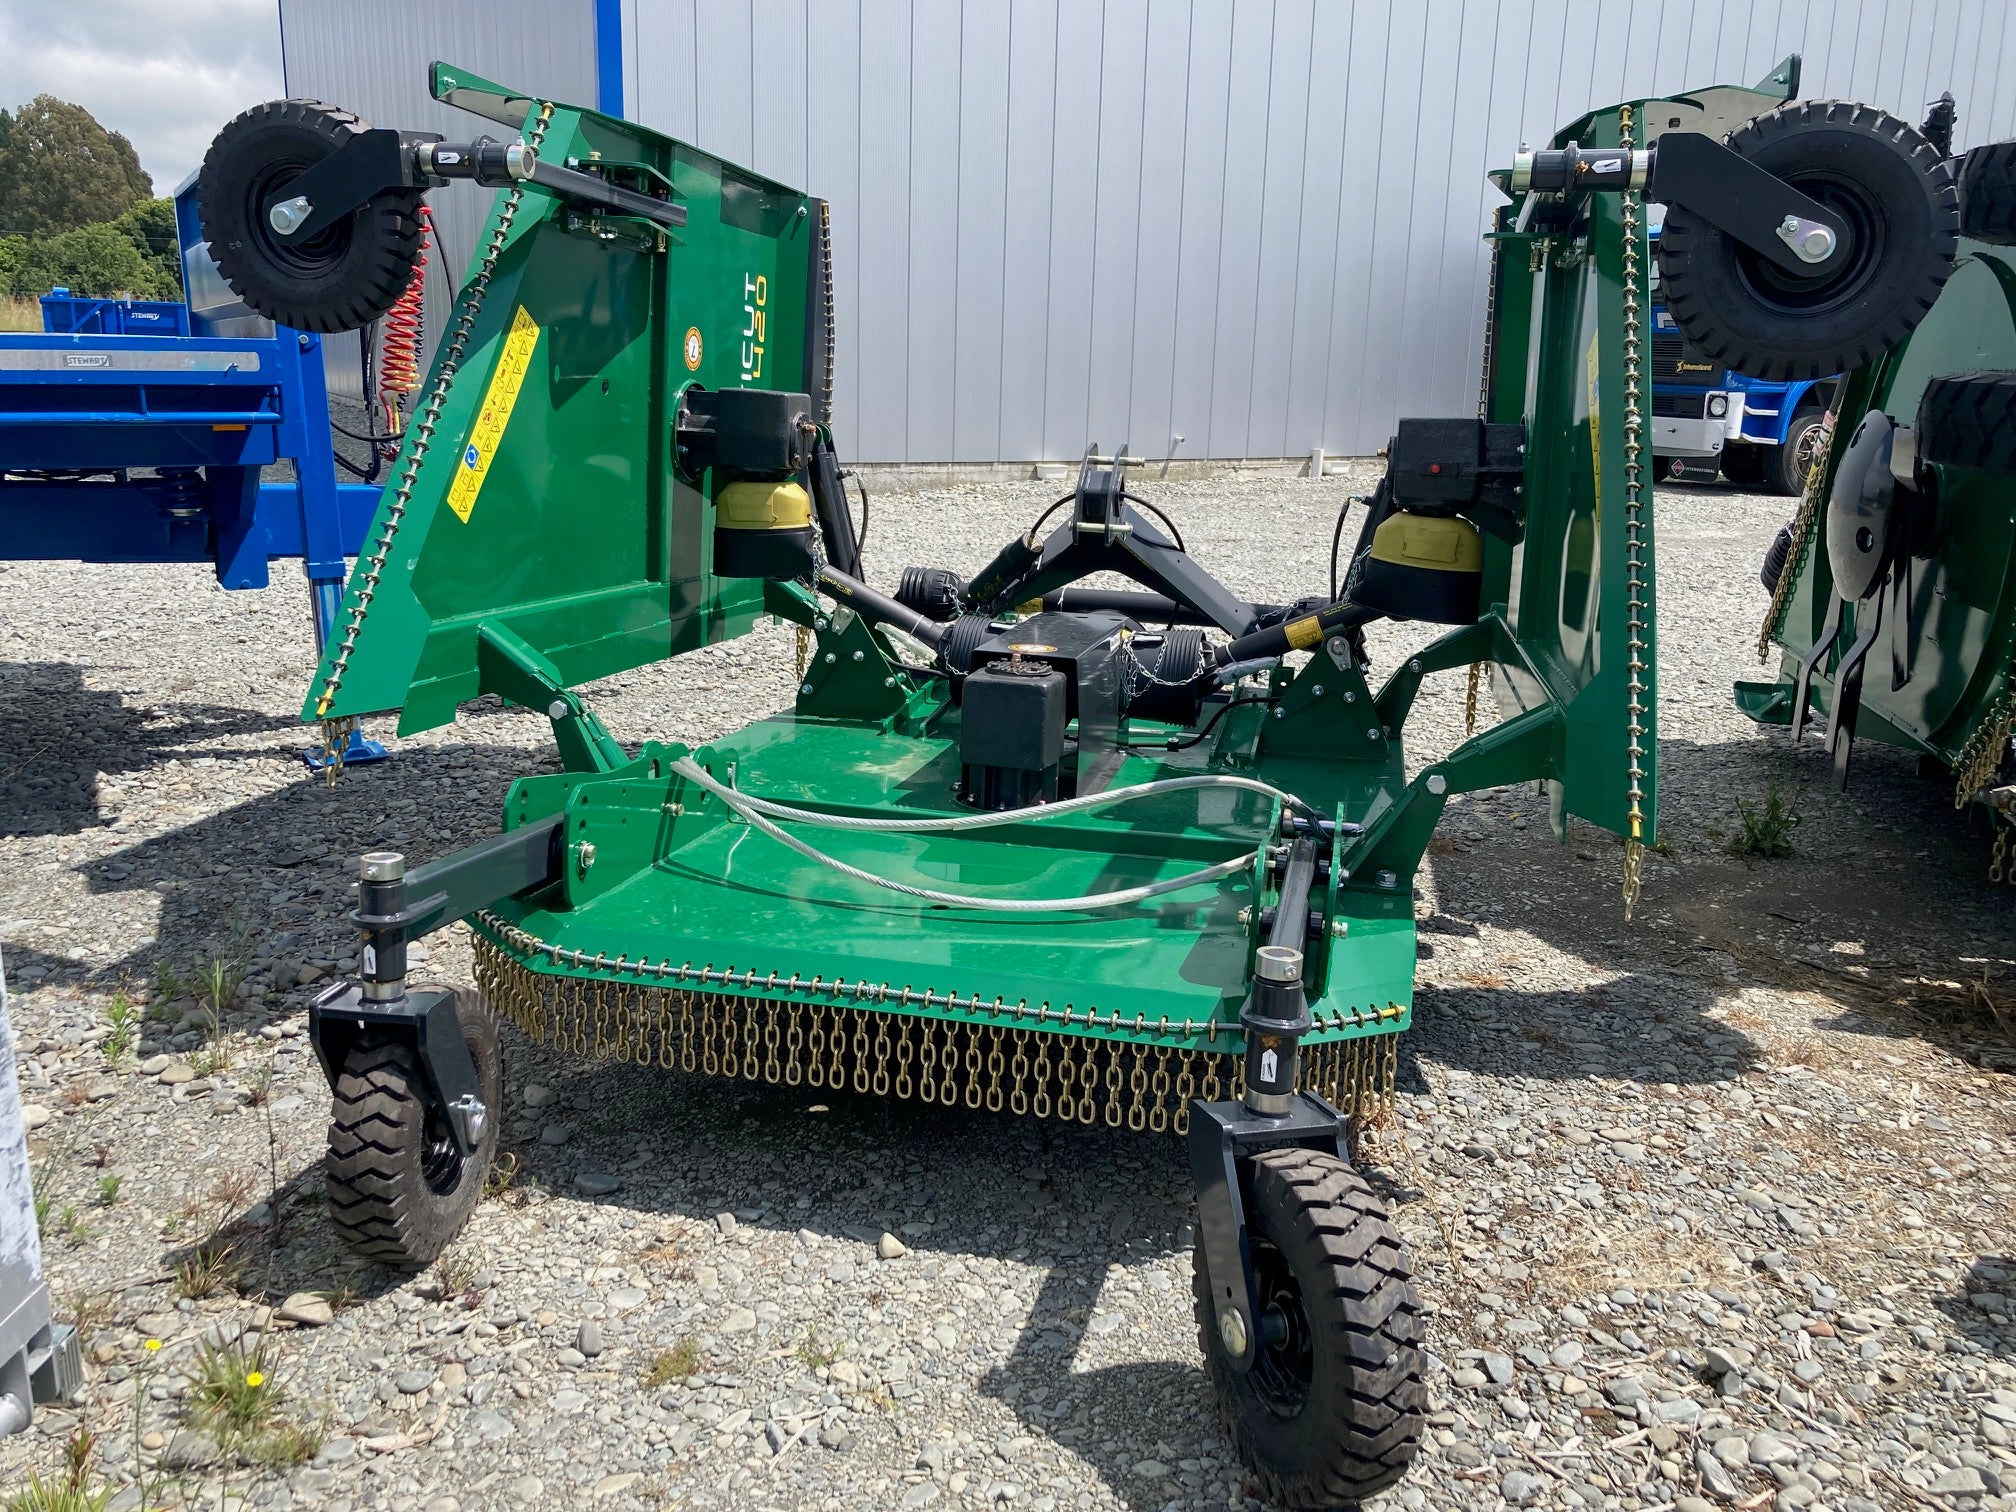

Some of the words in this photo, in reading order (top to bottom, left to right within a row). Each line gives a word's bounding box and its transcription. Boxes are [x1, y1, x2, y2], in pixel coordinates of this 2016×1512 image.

[131, 312, 159, 320] STEWART
[753, 275, 767, 378] 420
[67, 355, 108, 367] STEWART
